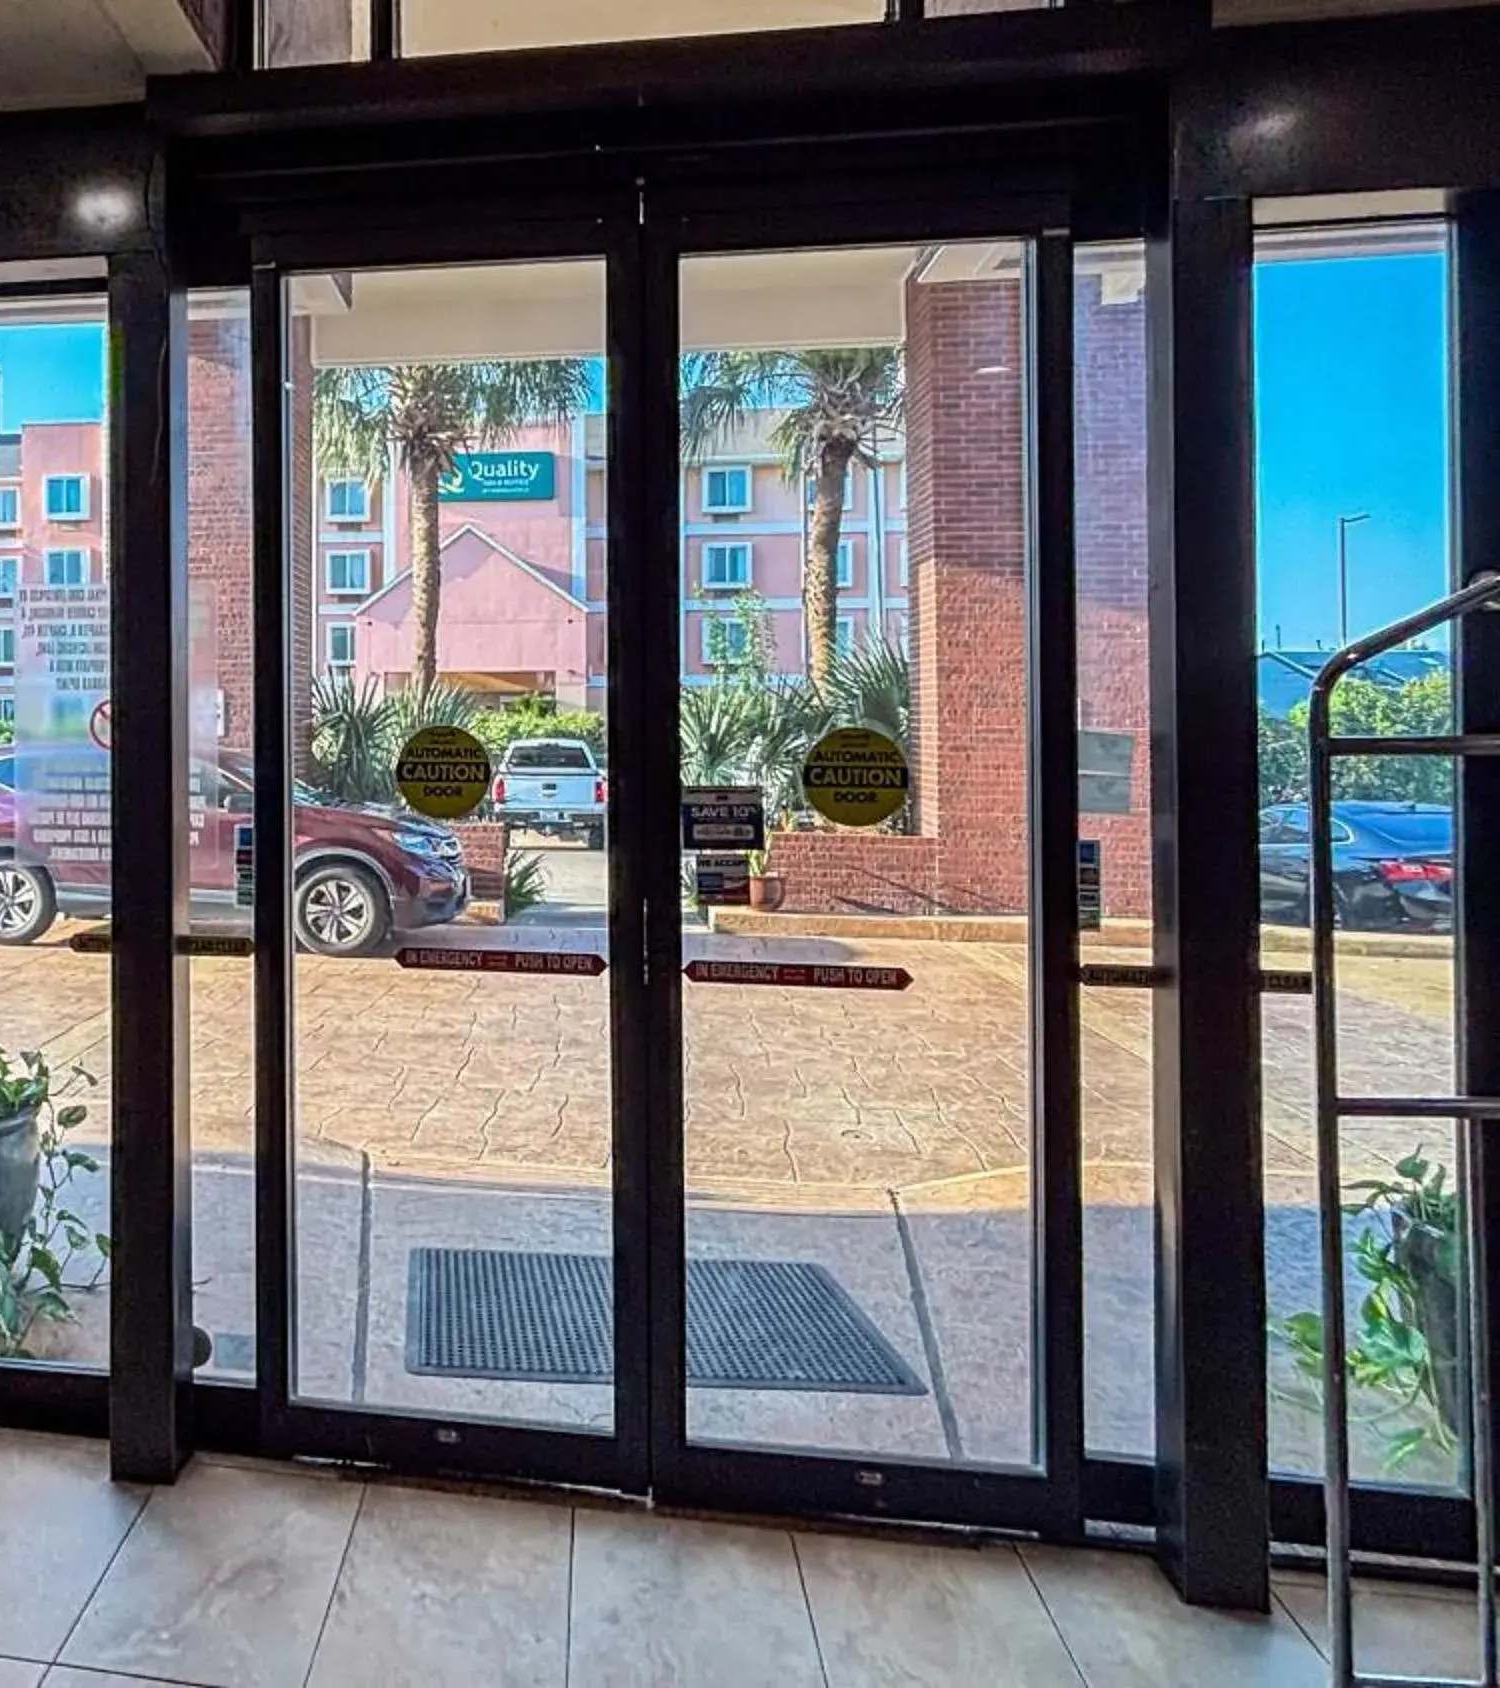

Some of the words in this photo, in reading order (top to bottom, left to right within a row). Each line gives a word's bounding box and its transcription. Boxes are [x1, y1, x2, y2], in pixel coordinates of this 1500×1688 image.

[468, 460, 539, 481] Quality
[406, 747, 483, 759] AUTOMATIC
[814, 750, 901, 763] AUTOMATIC
[402, 763, 485, 780] CAUTION
[810, 767, 901, 786] CAUTION
[424, 786, 462, 797] DOOR
[834, 791, 878, 803] DOOR
[691, 806, 729, 817] SAVE
[405, 951, 418, 964] IN
[419, 951, 484, 967] EMERGENCY
[515, 954, 543, 969] PUSH
[547, 956, 561, 969] TO
[562, 957, 592, 970] OPEN
[695, 963, 708, 978] IN
[711, 964, 779, 981] EMERGENCY
[813, 967, 844, 984] PUSH
[849, 969, 863, 984] TO
[865, 969, 897, 986] OPEN
